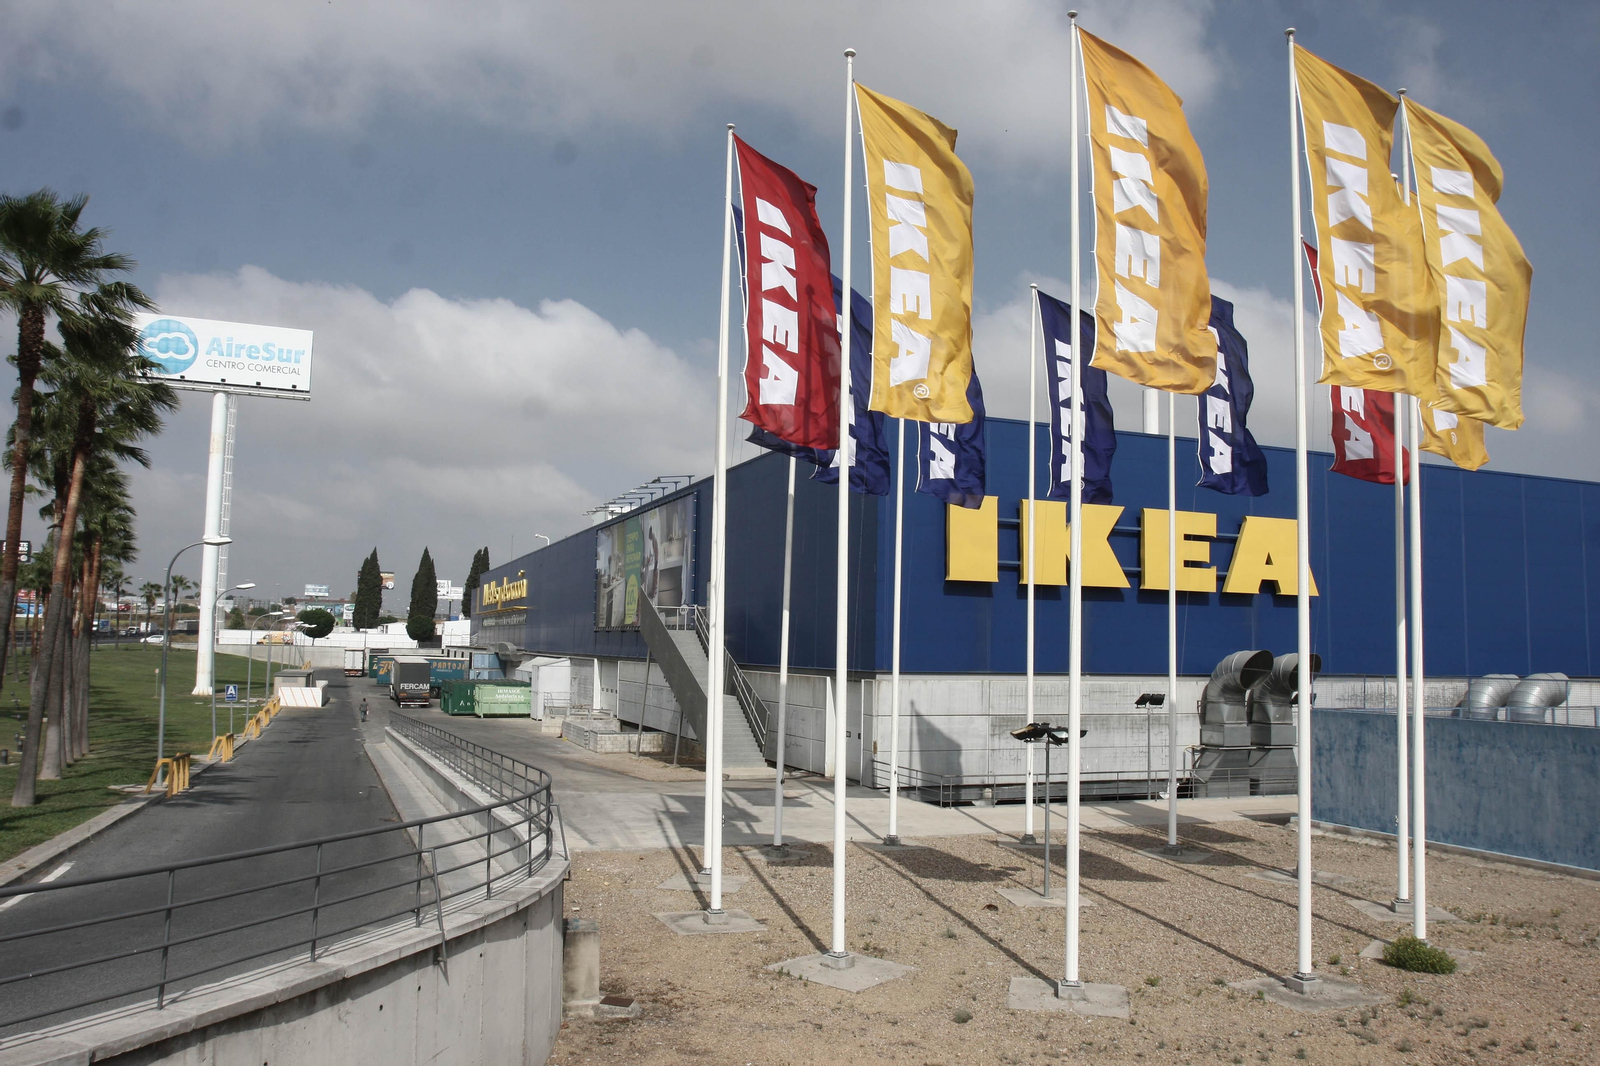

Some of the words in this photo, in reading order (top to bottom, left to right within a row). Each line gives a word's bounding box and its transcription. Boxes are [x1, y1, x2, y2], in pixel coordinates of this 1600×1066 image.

[756, 196, 799, 406] IKEA
[883, 158, 932, 387] IKEA
[1105, 104, 1161, 353] IKEA
[1322, 120, 1385, 358] IKEA
[1430, 166, 1487, 390] IKEA
[205, 337, 306, 364] AireSur
[206, 359, 246, 371] CENTRO
[247, 362, 301, 376] COMERCIAL
[1341, 385, 1375, 461] EA
[945, 495, 1319, 597] IKEA
[227, 685, 236, 694] A
